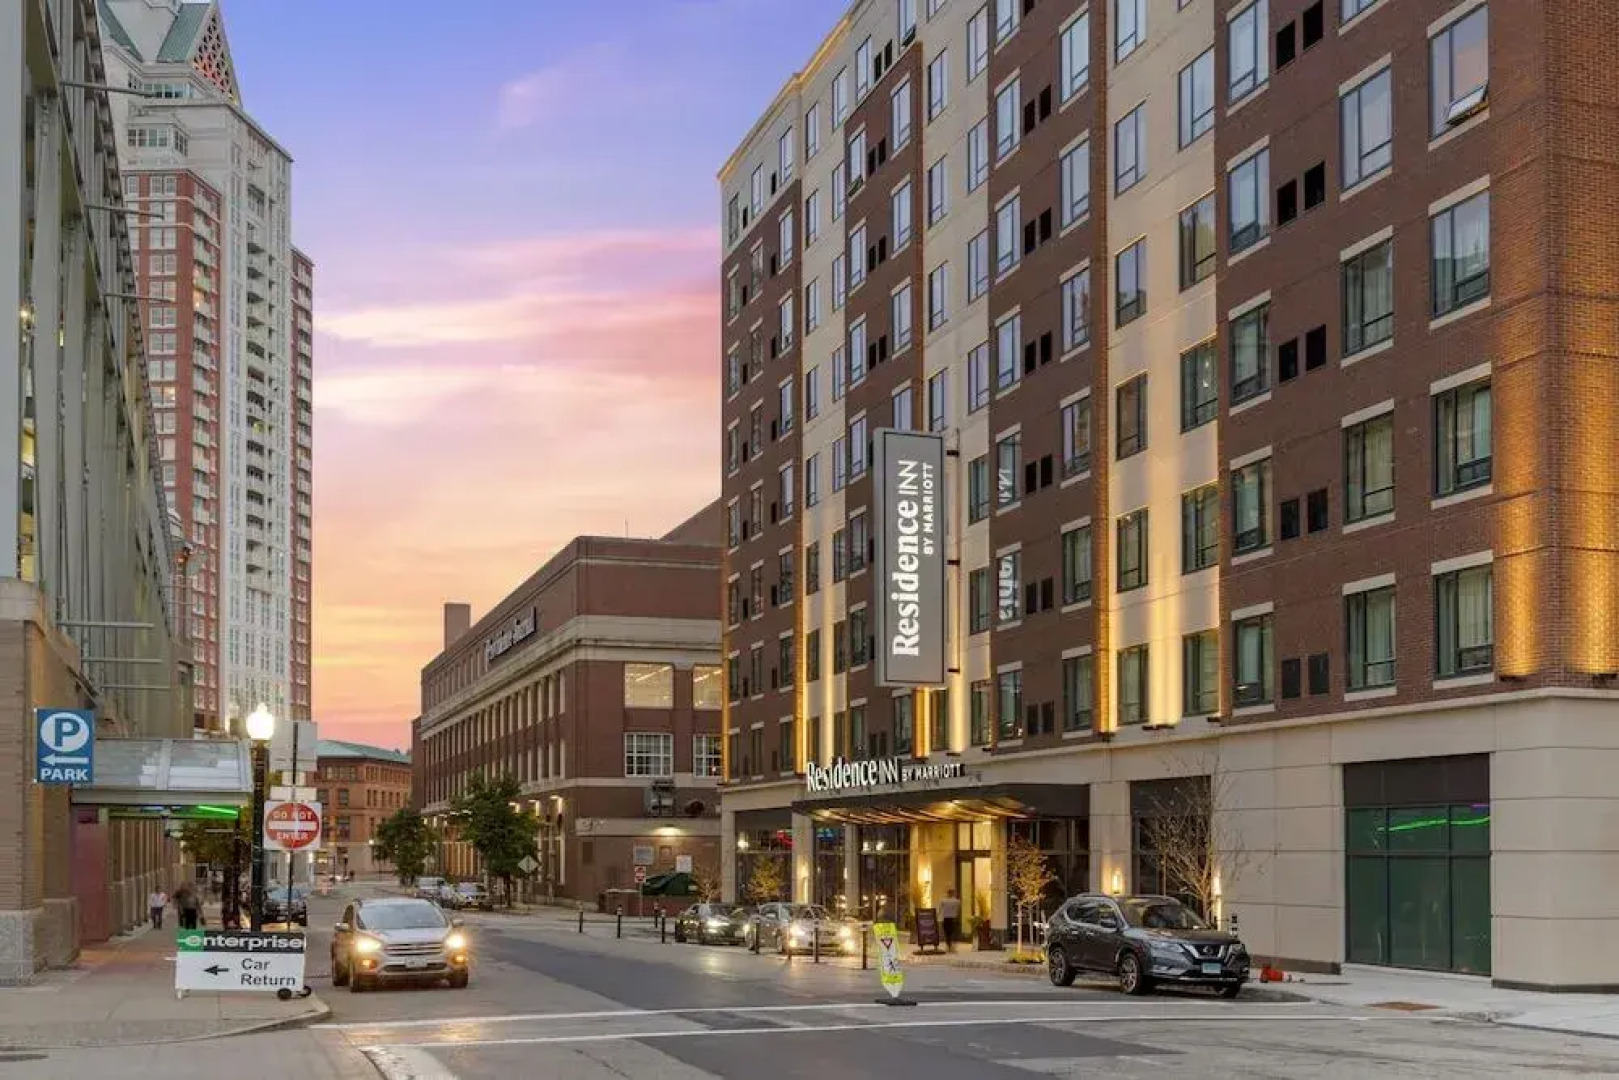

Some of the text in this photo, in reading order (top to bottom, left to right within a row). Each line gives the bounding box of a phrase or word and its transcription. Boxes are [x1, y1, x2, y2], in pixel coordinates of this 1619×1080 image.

[923, 462, 934, 555] BY MARRIOTT
[892, 460, 919, 657] Residence INN
[54, 717, 81, 748] P
[41, 768, 88, 781] PARK
[806, 755, 961, 792] Residence INN BY MARRIOTT
[273, 810, 288, 820] DO
[178, 934, 303, 951] enterprise
[241, 957, 270, 971] Car
[241, 973, 296, 986] Return
